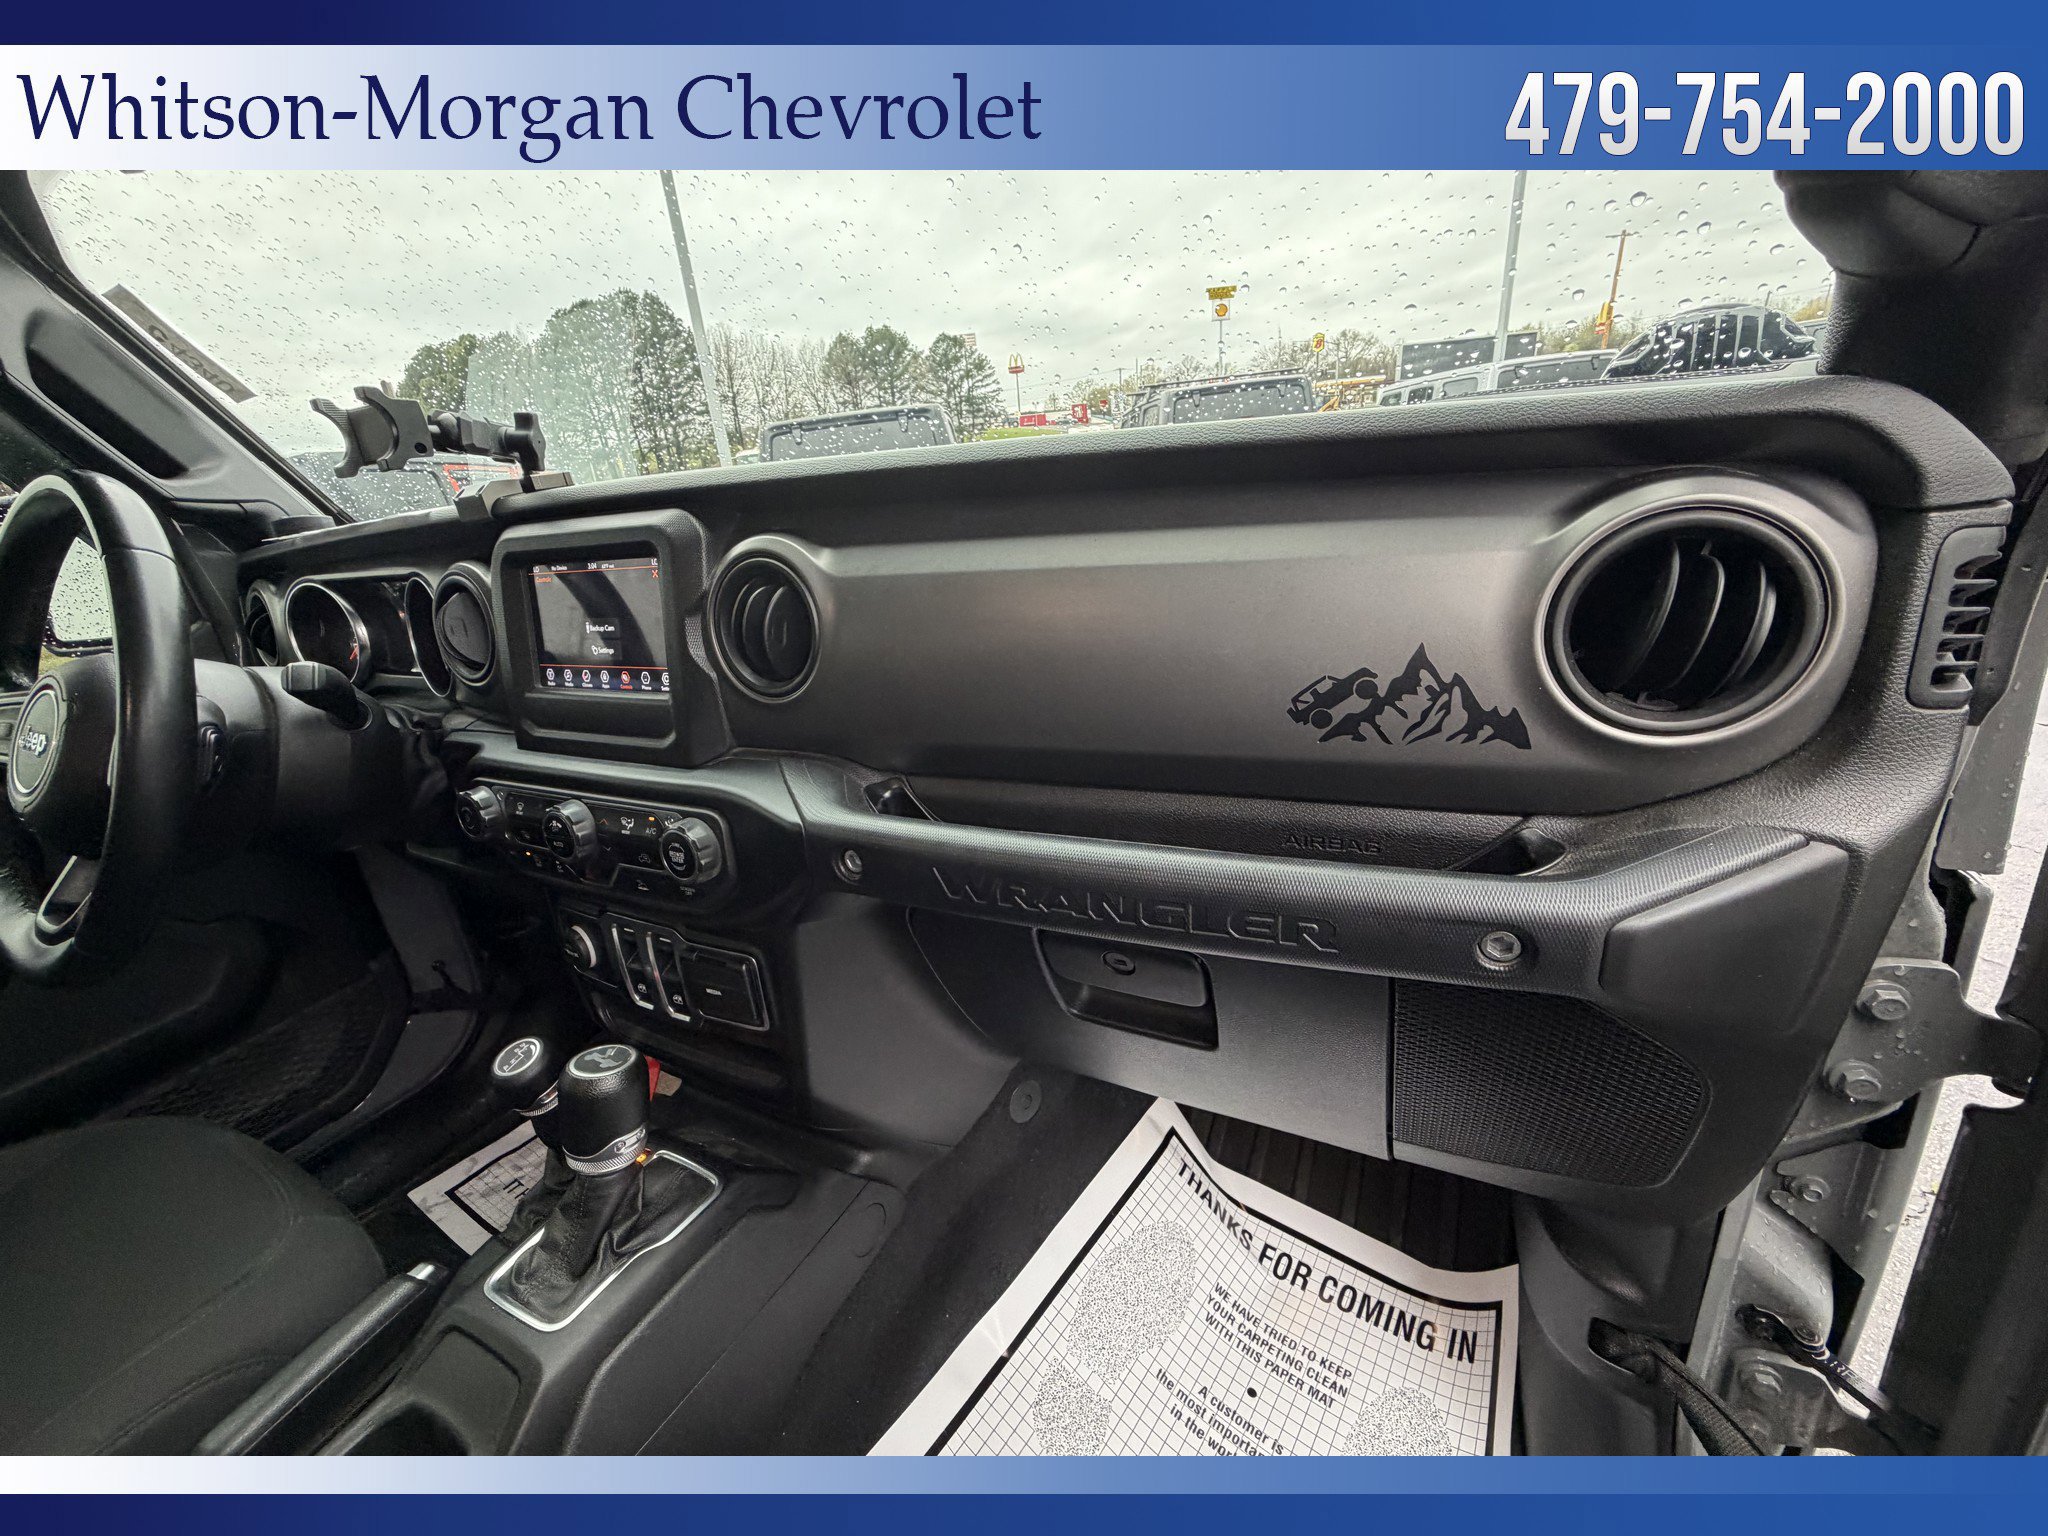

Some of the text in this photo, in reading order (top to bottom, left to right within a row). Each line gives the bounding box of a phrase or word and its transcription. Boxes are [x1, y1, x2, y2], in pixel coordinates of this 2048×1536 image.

[1281, 836, 1380, 856] AIRBAG
[932, 866, 1339, 954] WRANGLER
[1176, 1156, 1478, 1364] THANKS FOR COMING IN
[1205, 1311, 1336, 1409] WITH THIS PAPER MAT
[1207, 1293, 1349, 1399] YOUR CARPETING CLEAN
[1214, 1281, 1353, 1380] WE HAVE TRIED TO KEEP
[1156, 1368, 1175, 1391] the
[1176, 1388, 1208, 1419] most
[1170, 1403, 1183, 1421] in
[1184, 1416, 1205, 1440] the
[1198, 1385, 1284, 1456] A customer is
